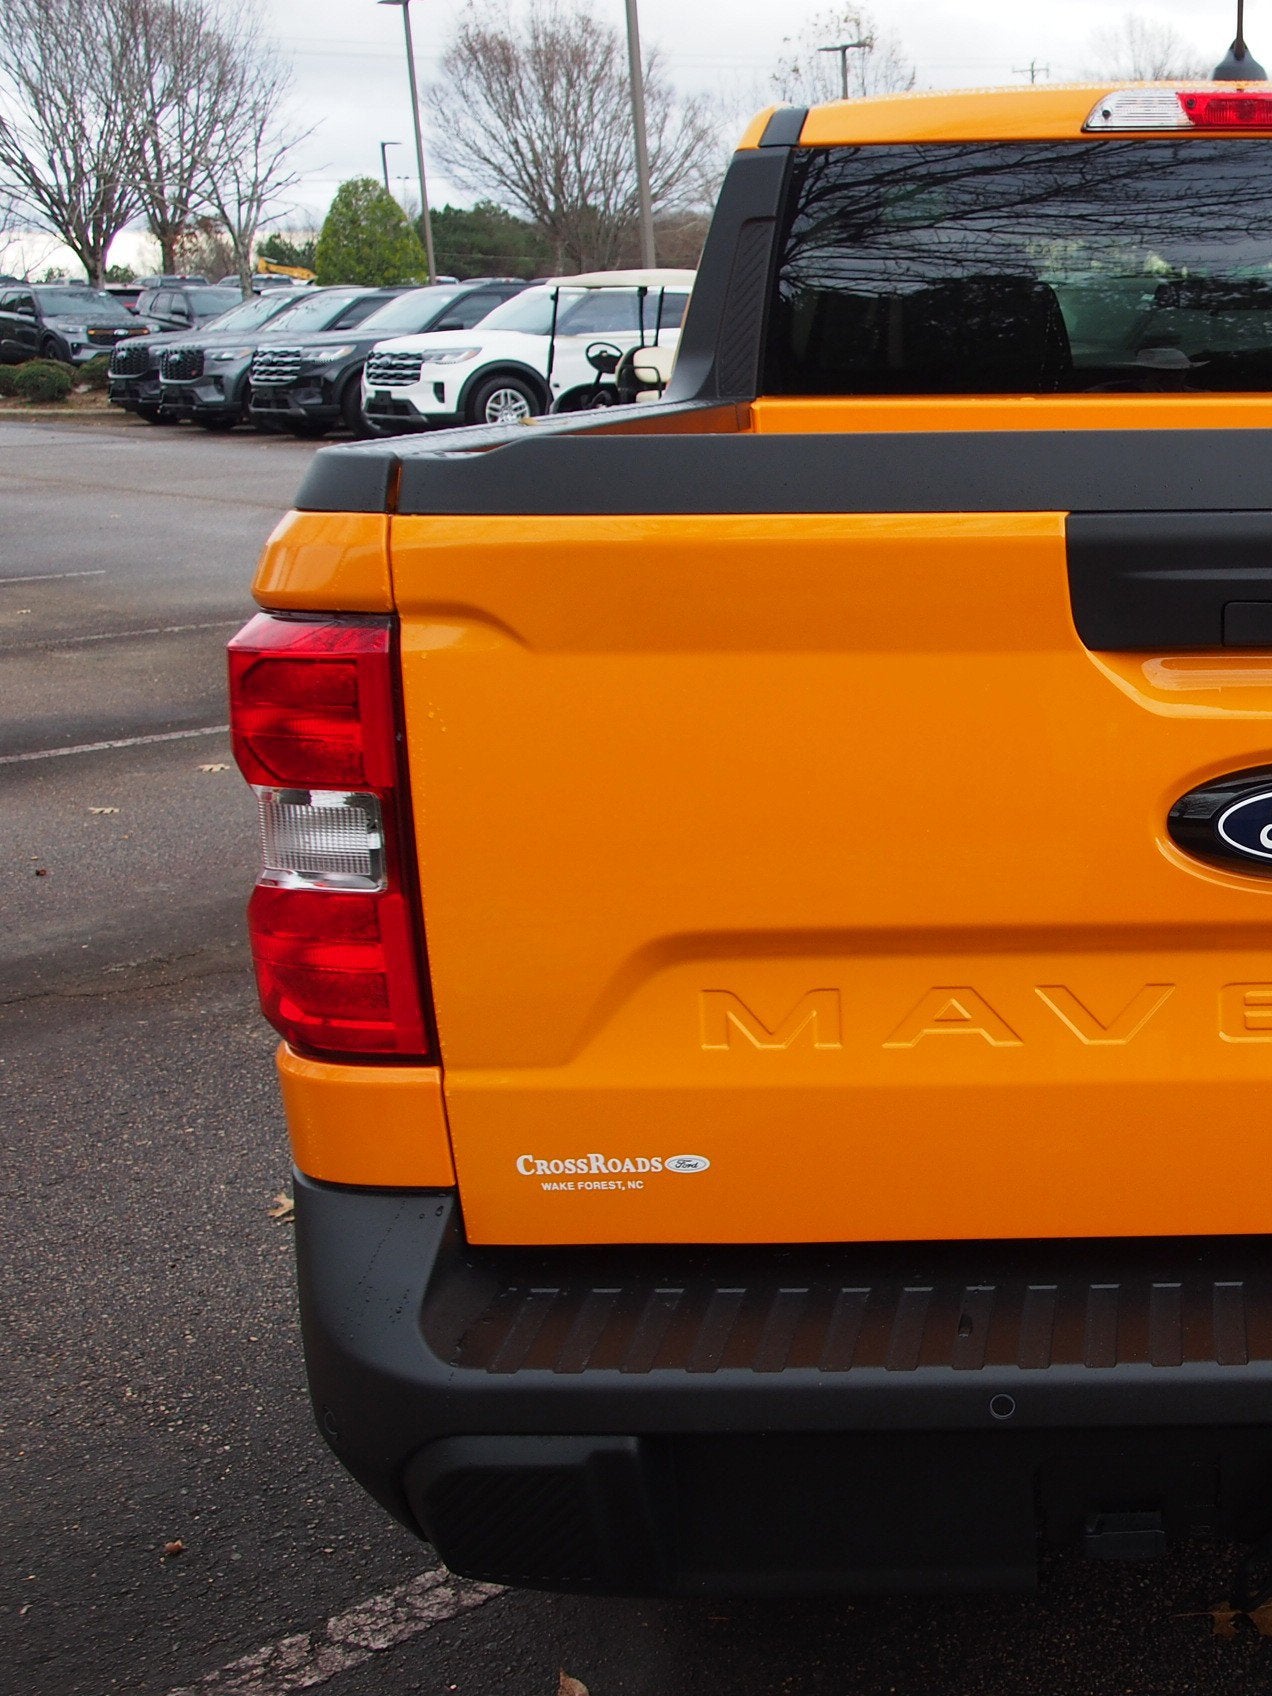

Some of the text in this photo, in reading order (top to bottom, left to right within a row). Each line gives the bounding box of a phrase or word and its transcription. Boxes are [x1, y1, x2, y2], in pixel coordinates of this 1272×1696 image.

[674, 1159, 699, 1169] Ford
[541, 1180, 644, 1191] WAKE FOREST, NC
